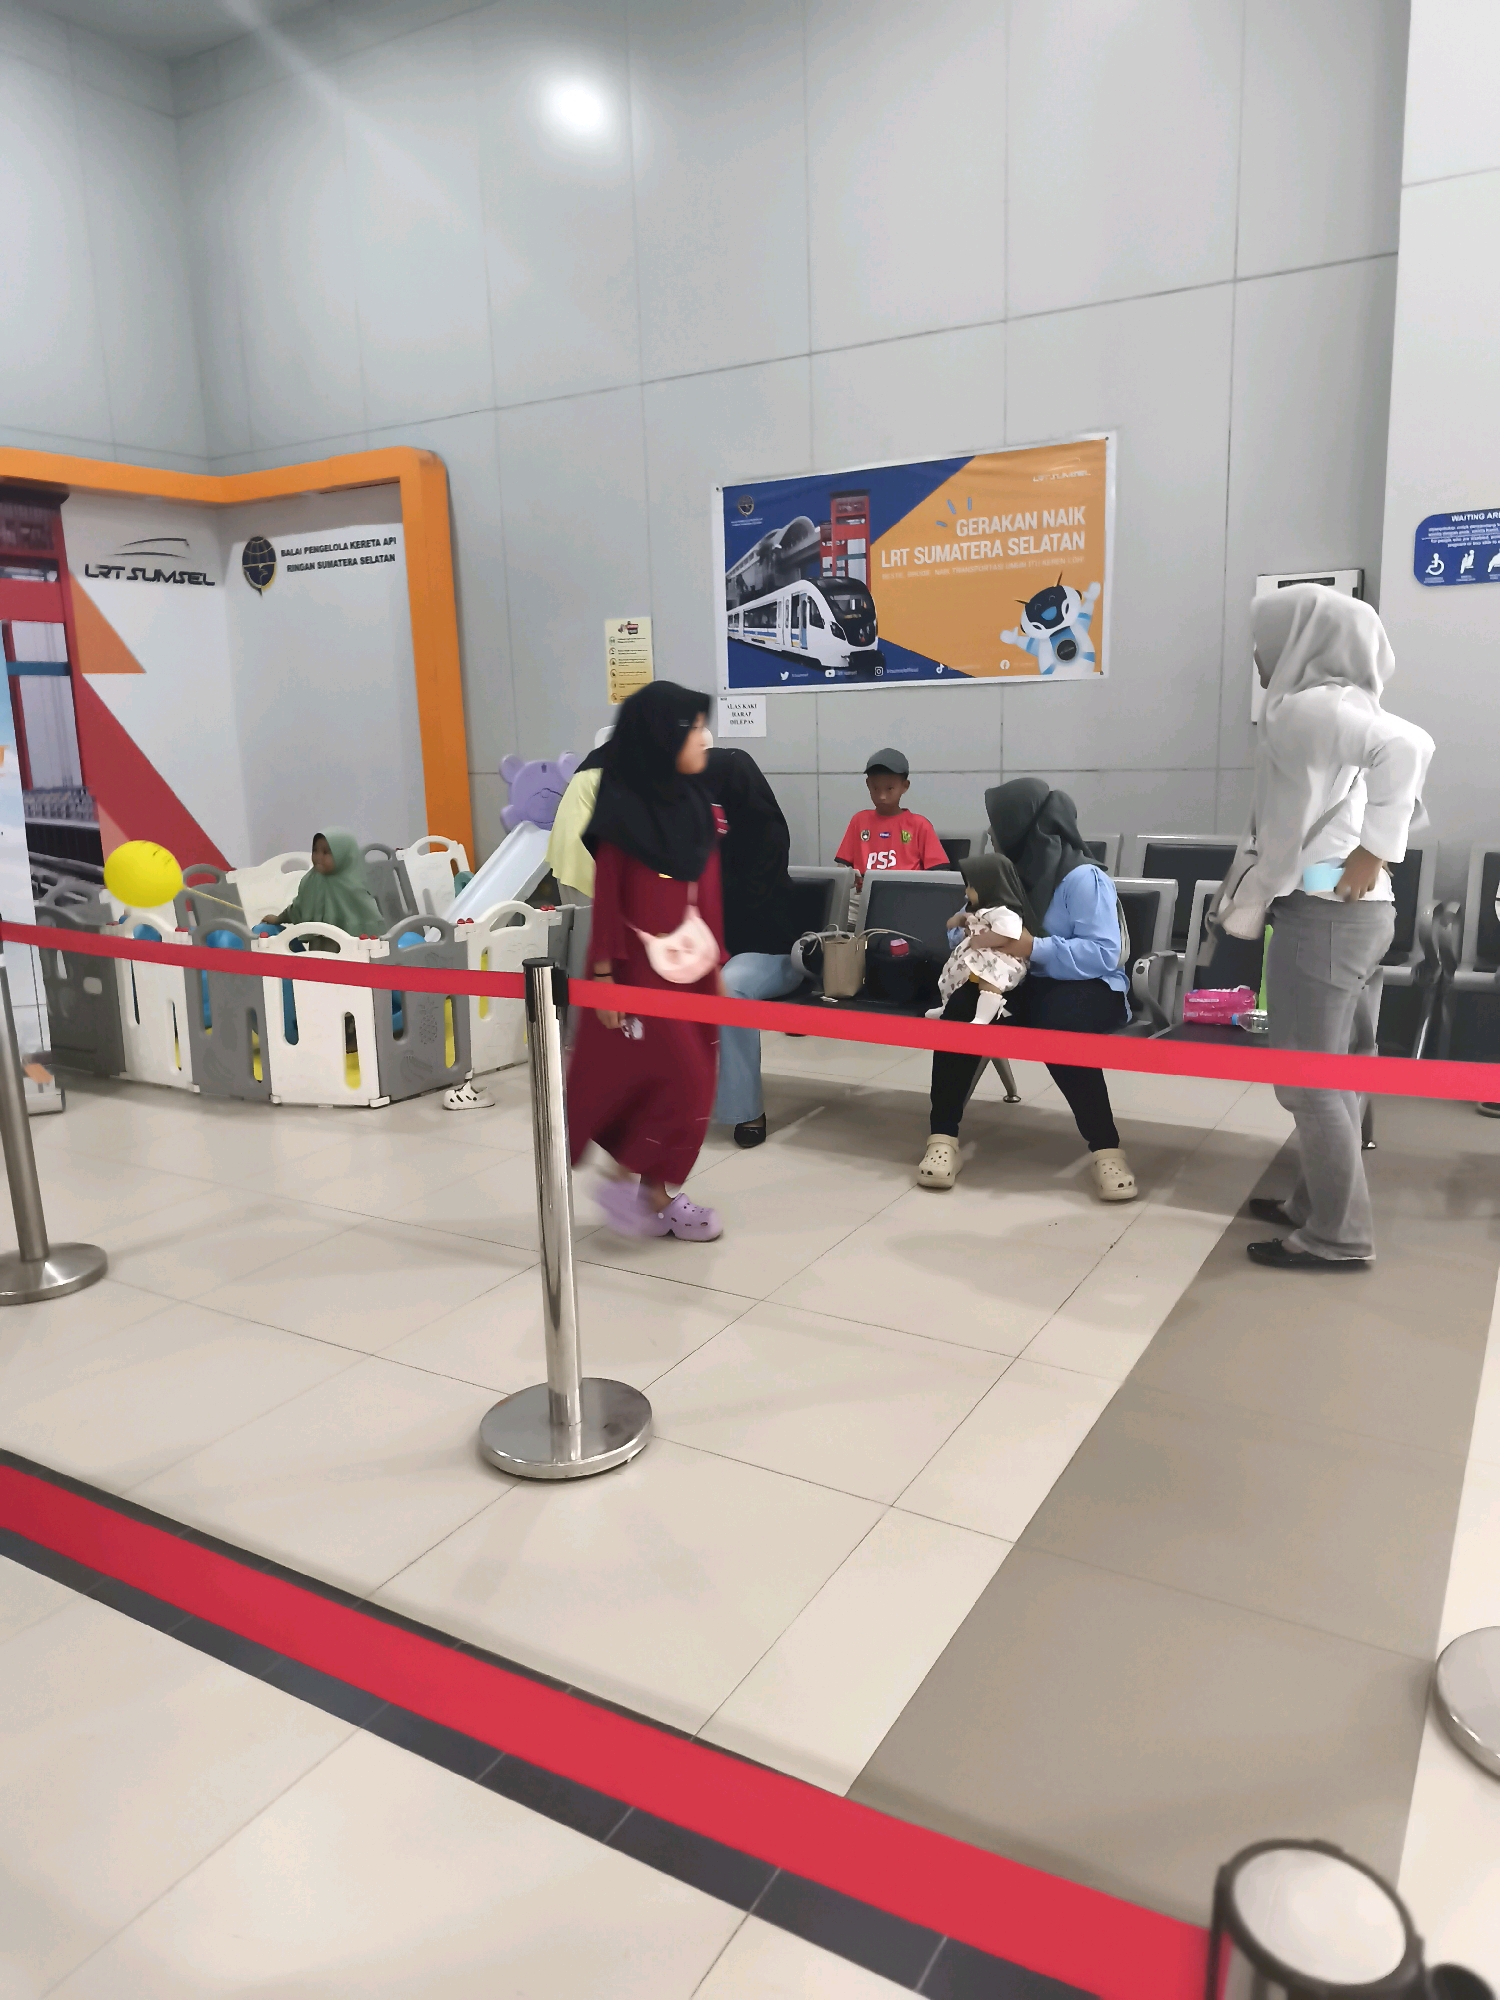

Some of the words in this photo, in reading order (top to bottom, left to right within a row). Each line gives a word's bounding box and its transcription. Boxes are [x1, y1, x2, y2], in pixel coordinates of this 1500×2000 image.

[956, 511, 1037, 537] GERAKAN
[1042, 506, 1086, 527] NAIK
[1451, 513, 1485, 522] WAITING
[1486, 511, 1500, 520] AR
[281, 547, 302, 557] BALAI
[304, 542, 349, 554] PENGELOLA
[349, 538, 381, 550] KERETA
[382, 536, 397, 546] API
[881, 548, 910, 568] LRT
[913, 540, 1004, 565] SUMATERA
[1007, 530, 1086, 556] SELATAN
[286, 561, 315, 572] RINGAN
[317, 557, 358, 570] SUMATERA
[360, 554, 396, 565] SELATAN
[84, 563, 125, 580] LRT
[126, 566, 216, 586] SUMSEL
